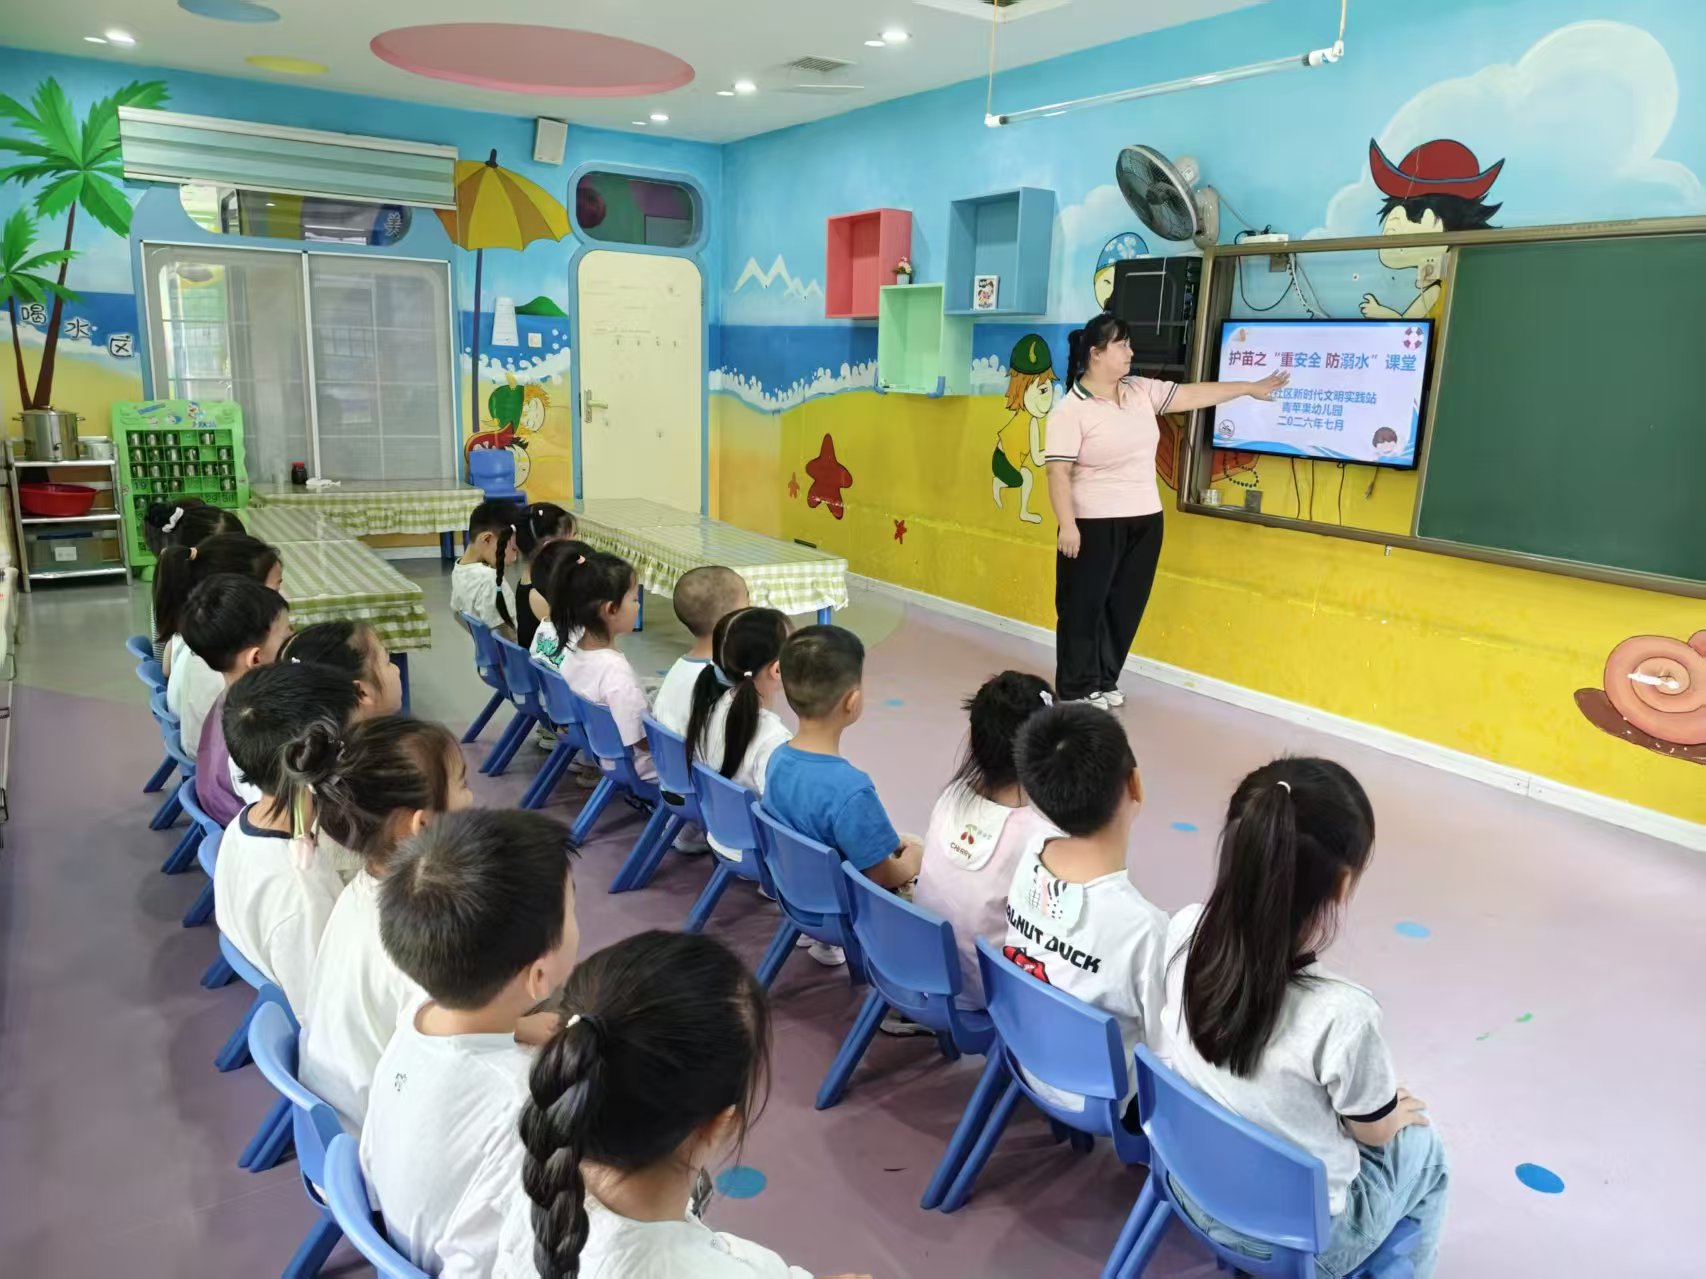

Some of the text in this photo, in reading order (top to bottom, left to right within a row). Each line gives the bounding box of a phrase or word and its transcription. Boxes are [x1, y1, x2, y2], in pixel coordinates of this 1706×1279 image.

[21, 304, 132, 357] 喝水区
[1282, 402, 1343, 416] 青苹果幼儿园
[1044, 936, 1101, 973] DUCK
